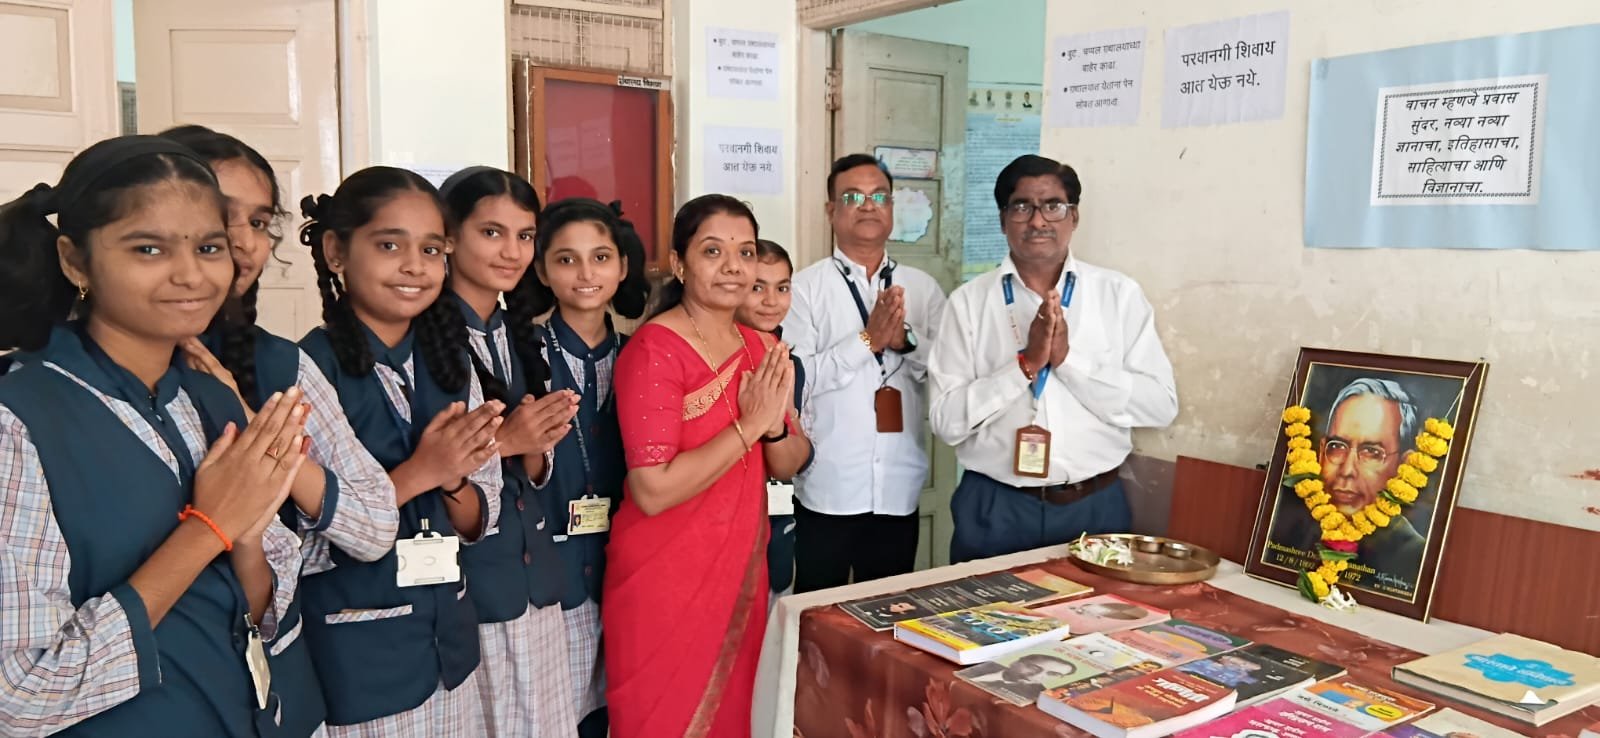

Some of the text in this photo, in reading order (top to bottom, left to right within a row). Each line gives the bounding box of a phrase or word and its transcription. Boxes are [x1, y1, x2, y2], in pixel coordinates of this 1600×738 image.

[1181, 41, 1276, 67] परवानगी शिवाय
[1180, 68, 1260, 95] आत येऊ नये.
[1405, 91, 1520, 112] वाचन म्हणजे प्रवास
[1411, 114, 1510, 135] सुंदर, नव्या नव्या
[1395, 134, 1519, 153] ज्ञानाचा, इतिहासाचा,
[723, 163, 739, 172] आत
[1407, 154, 1507, 176] साहित्याचा आणि
[1422, 179, 1483, 194] विज्ञानाचा.
